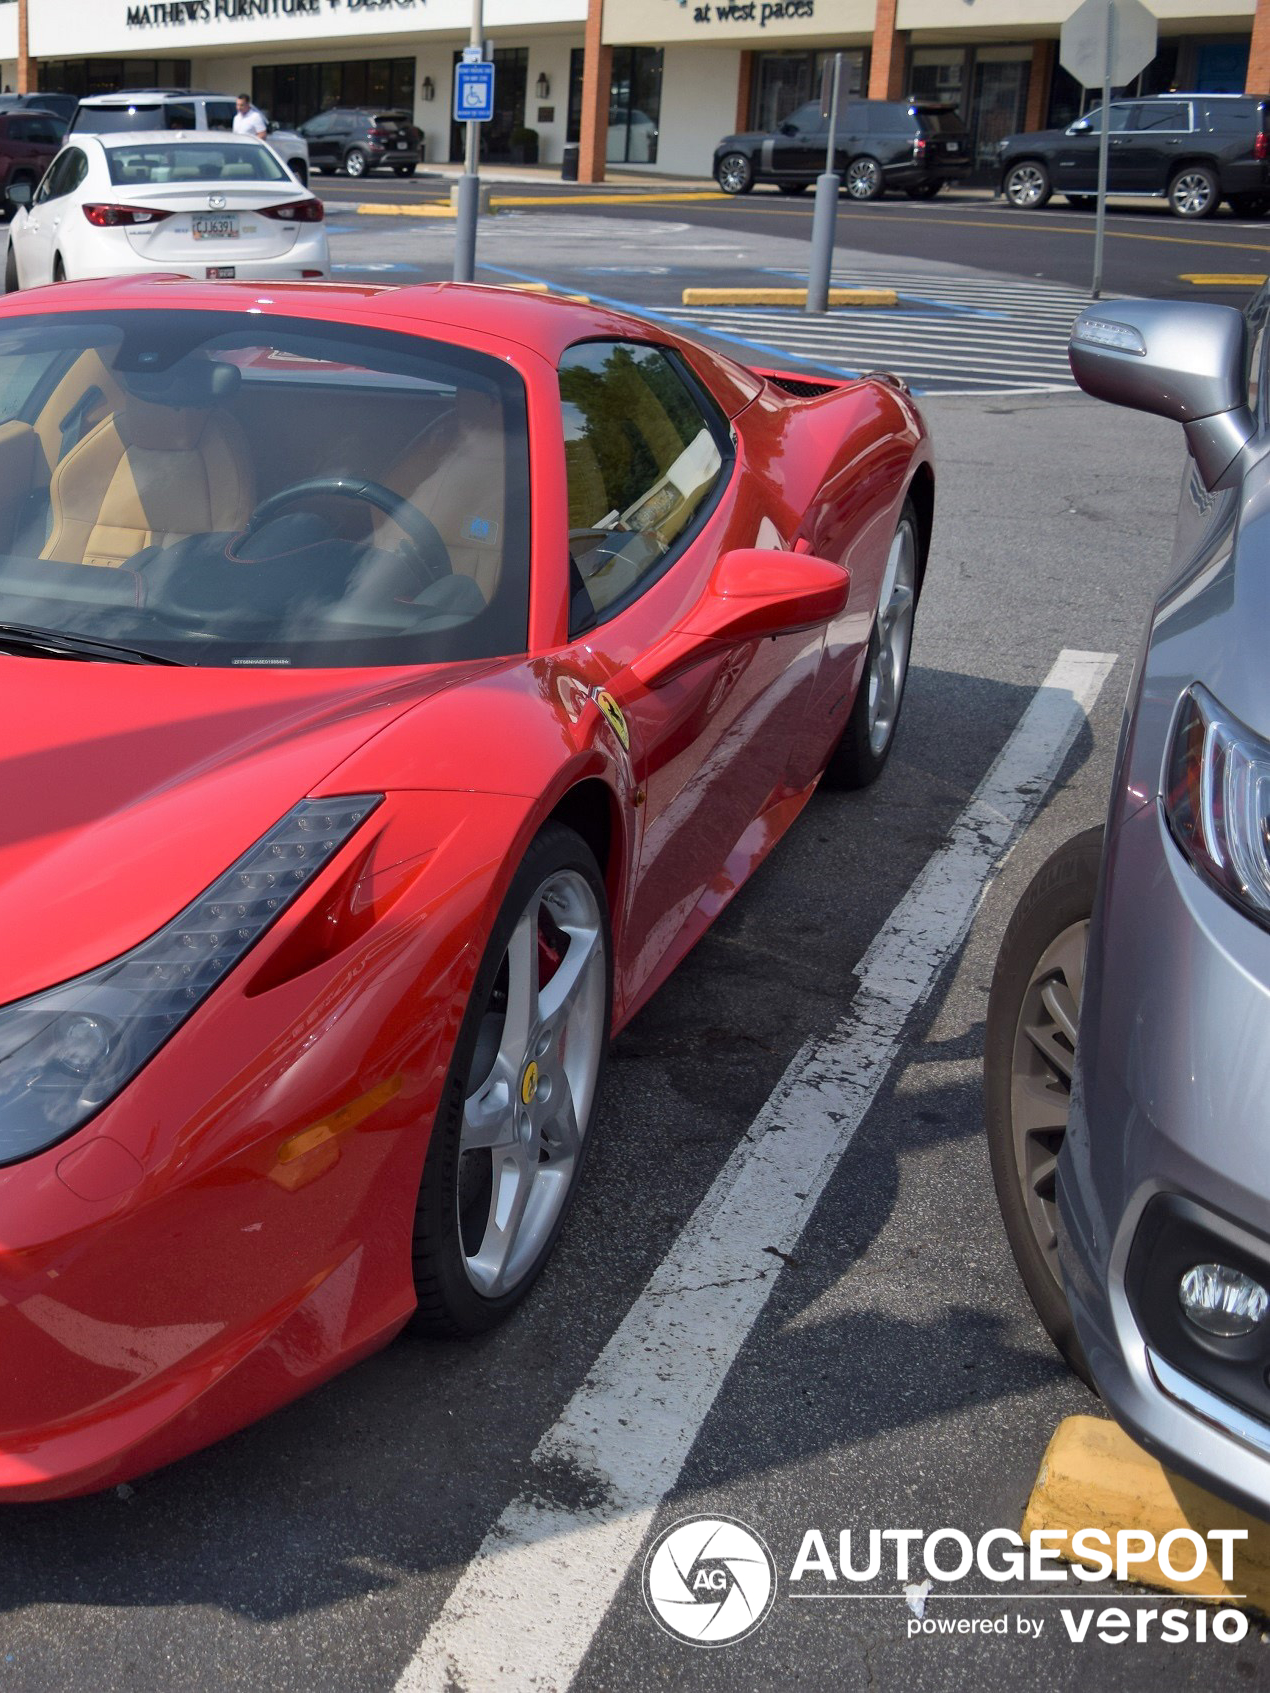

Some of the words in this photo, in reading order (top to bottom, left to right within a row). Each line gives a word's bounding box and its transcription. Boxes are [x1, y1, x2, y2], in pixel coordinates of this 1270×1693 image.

[127, 1, 210, 26] MATHEWS
[693, 3, 711, 23] at
[716, 1, 756, 21] west
[760, 0, 815, 27] paces
